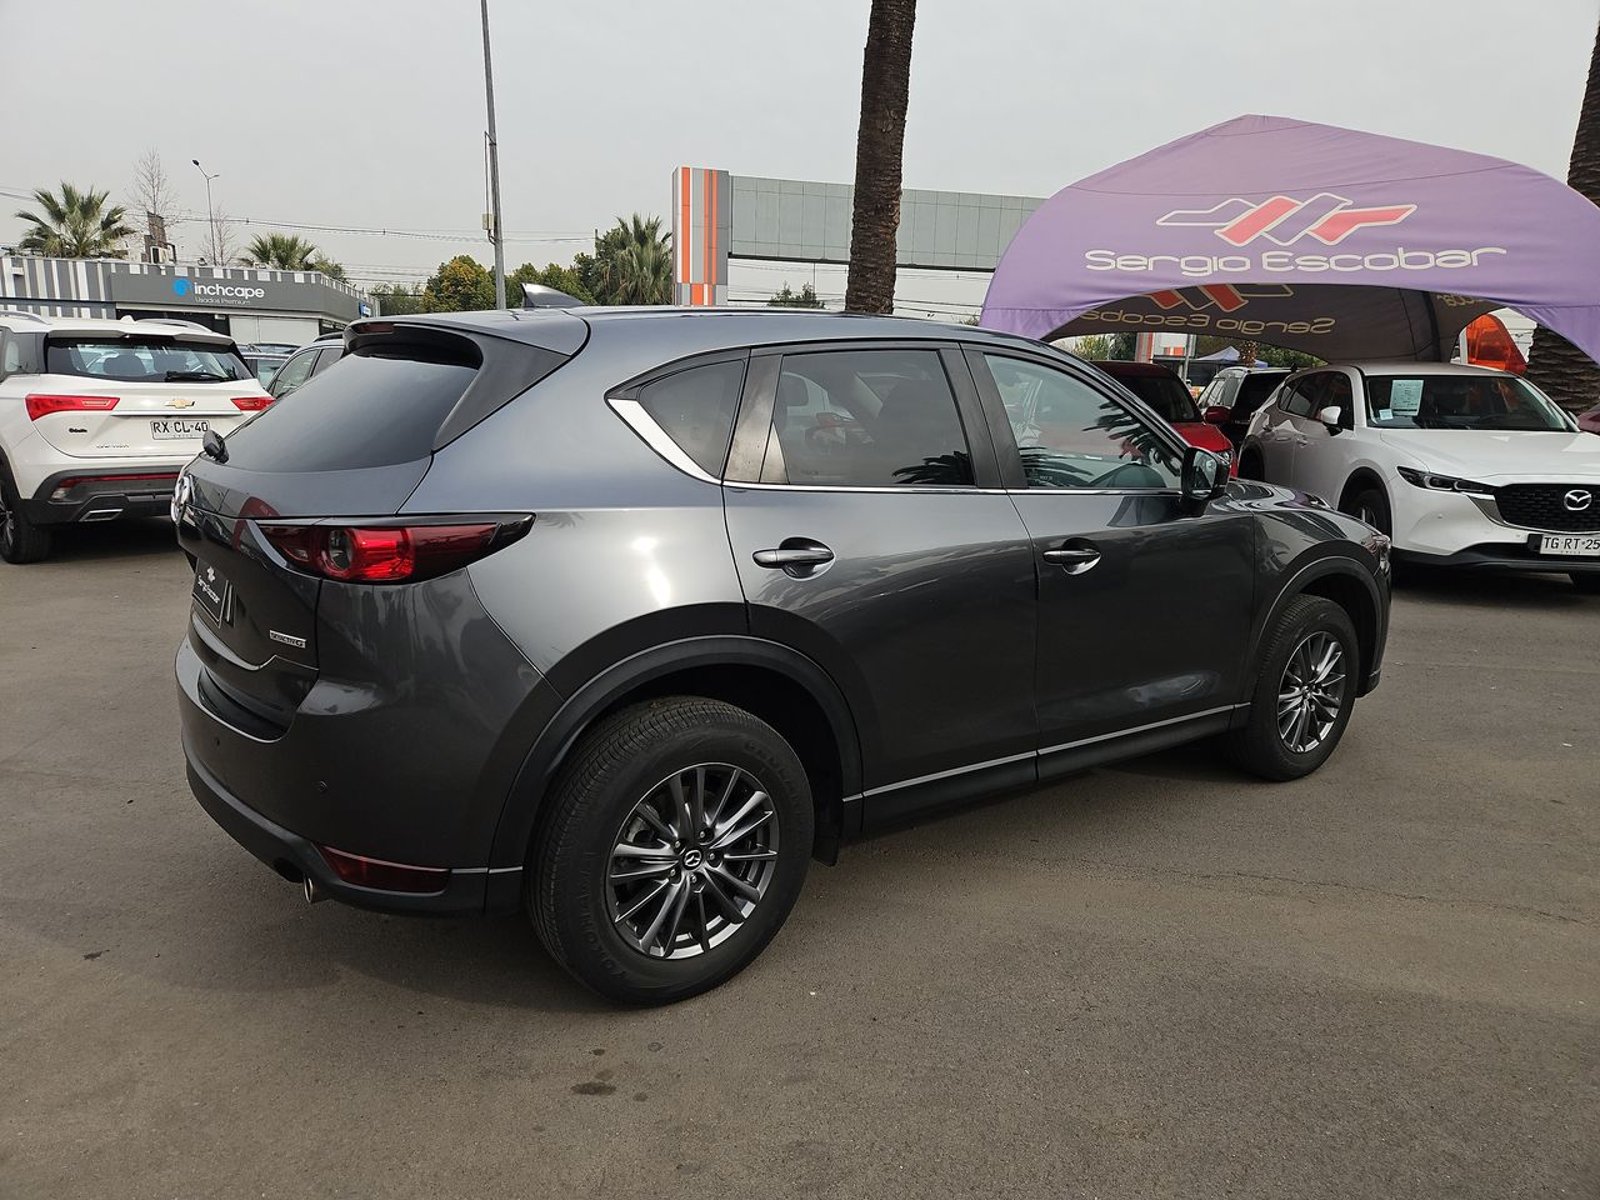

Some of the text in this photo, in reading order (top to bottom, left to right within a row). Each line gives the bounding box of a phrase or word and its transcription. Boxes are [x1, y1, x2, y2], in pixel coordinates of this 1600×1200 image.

[1084, 246, 1507, 277] Sergio Escobar
[194, 282, 265, 299] inchcape
